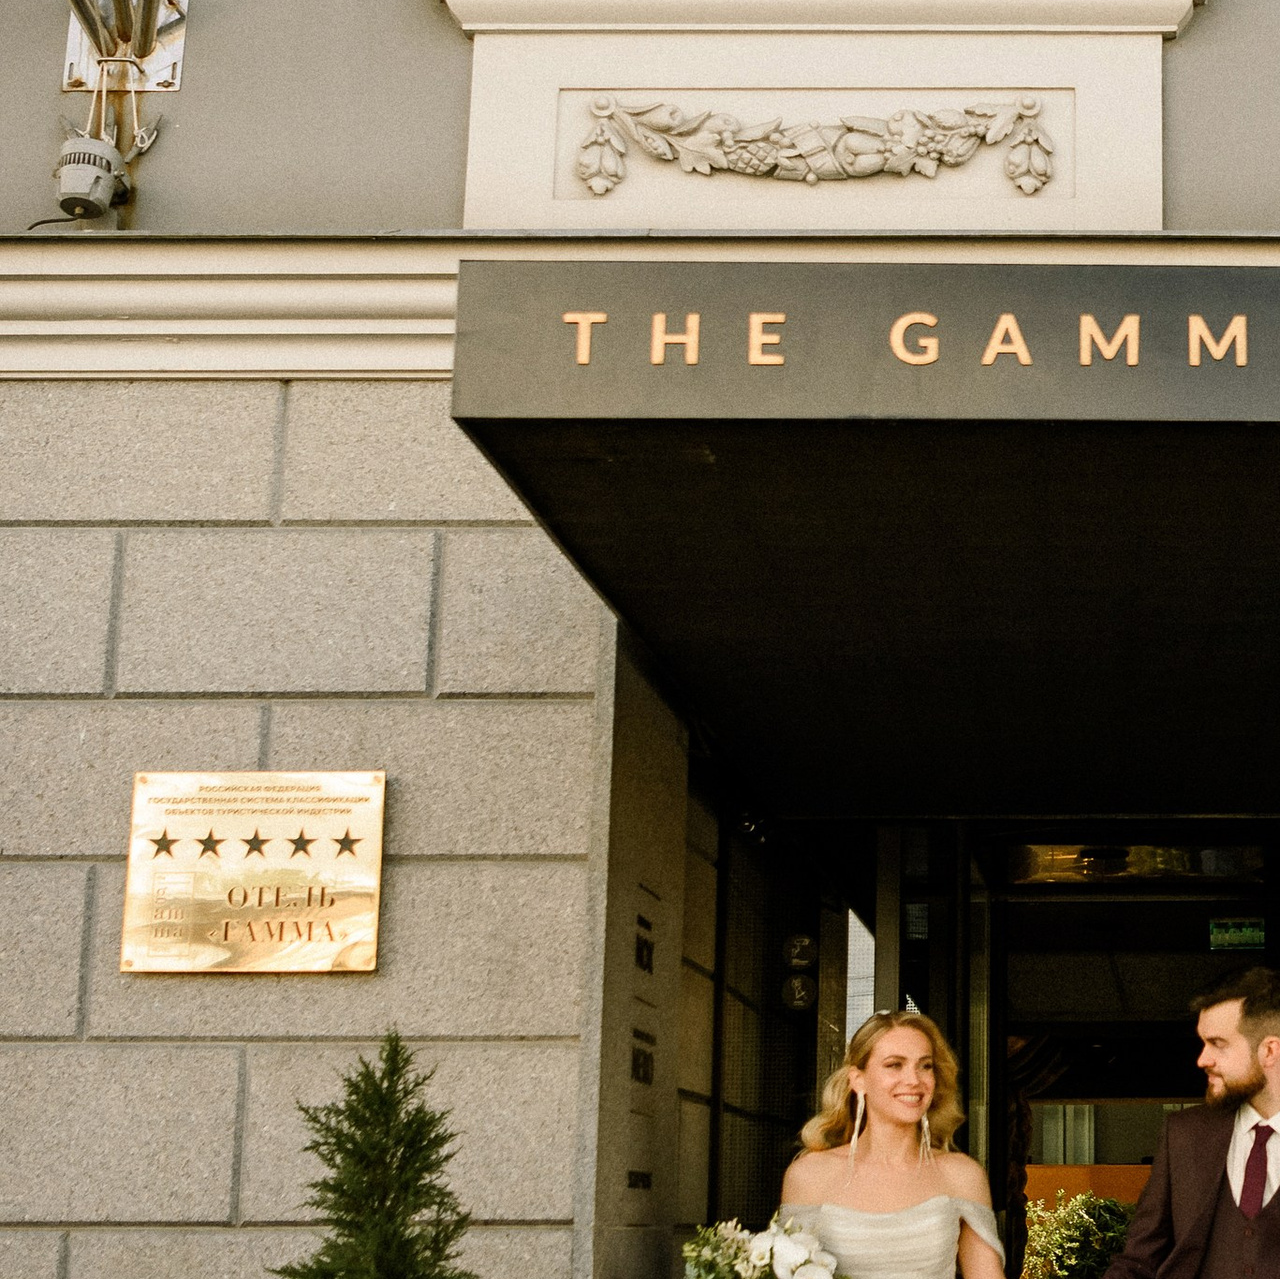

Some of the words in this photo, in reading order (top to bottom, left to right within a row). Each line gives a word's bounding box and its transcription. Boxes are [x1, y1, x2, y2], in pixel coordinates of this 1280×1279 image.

[563, 312, 787, 365] THE
[199, 785, 262, 793] РОССИЙСКАЯ
[264, 785, 321, 793] ФЕДЕРАЦИЯ
[148, 797, 238, 805] ГОСУДАРСТВЕННАЯ
[217, 808, 294, 816] ТУРИСТИЧЕСКОЙ
[296, 808, 352, 816] ИНДУСТРИИ
[227, 885, 336, 909] ОТЕЛЬ
